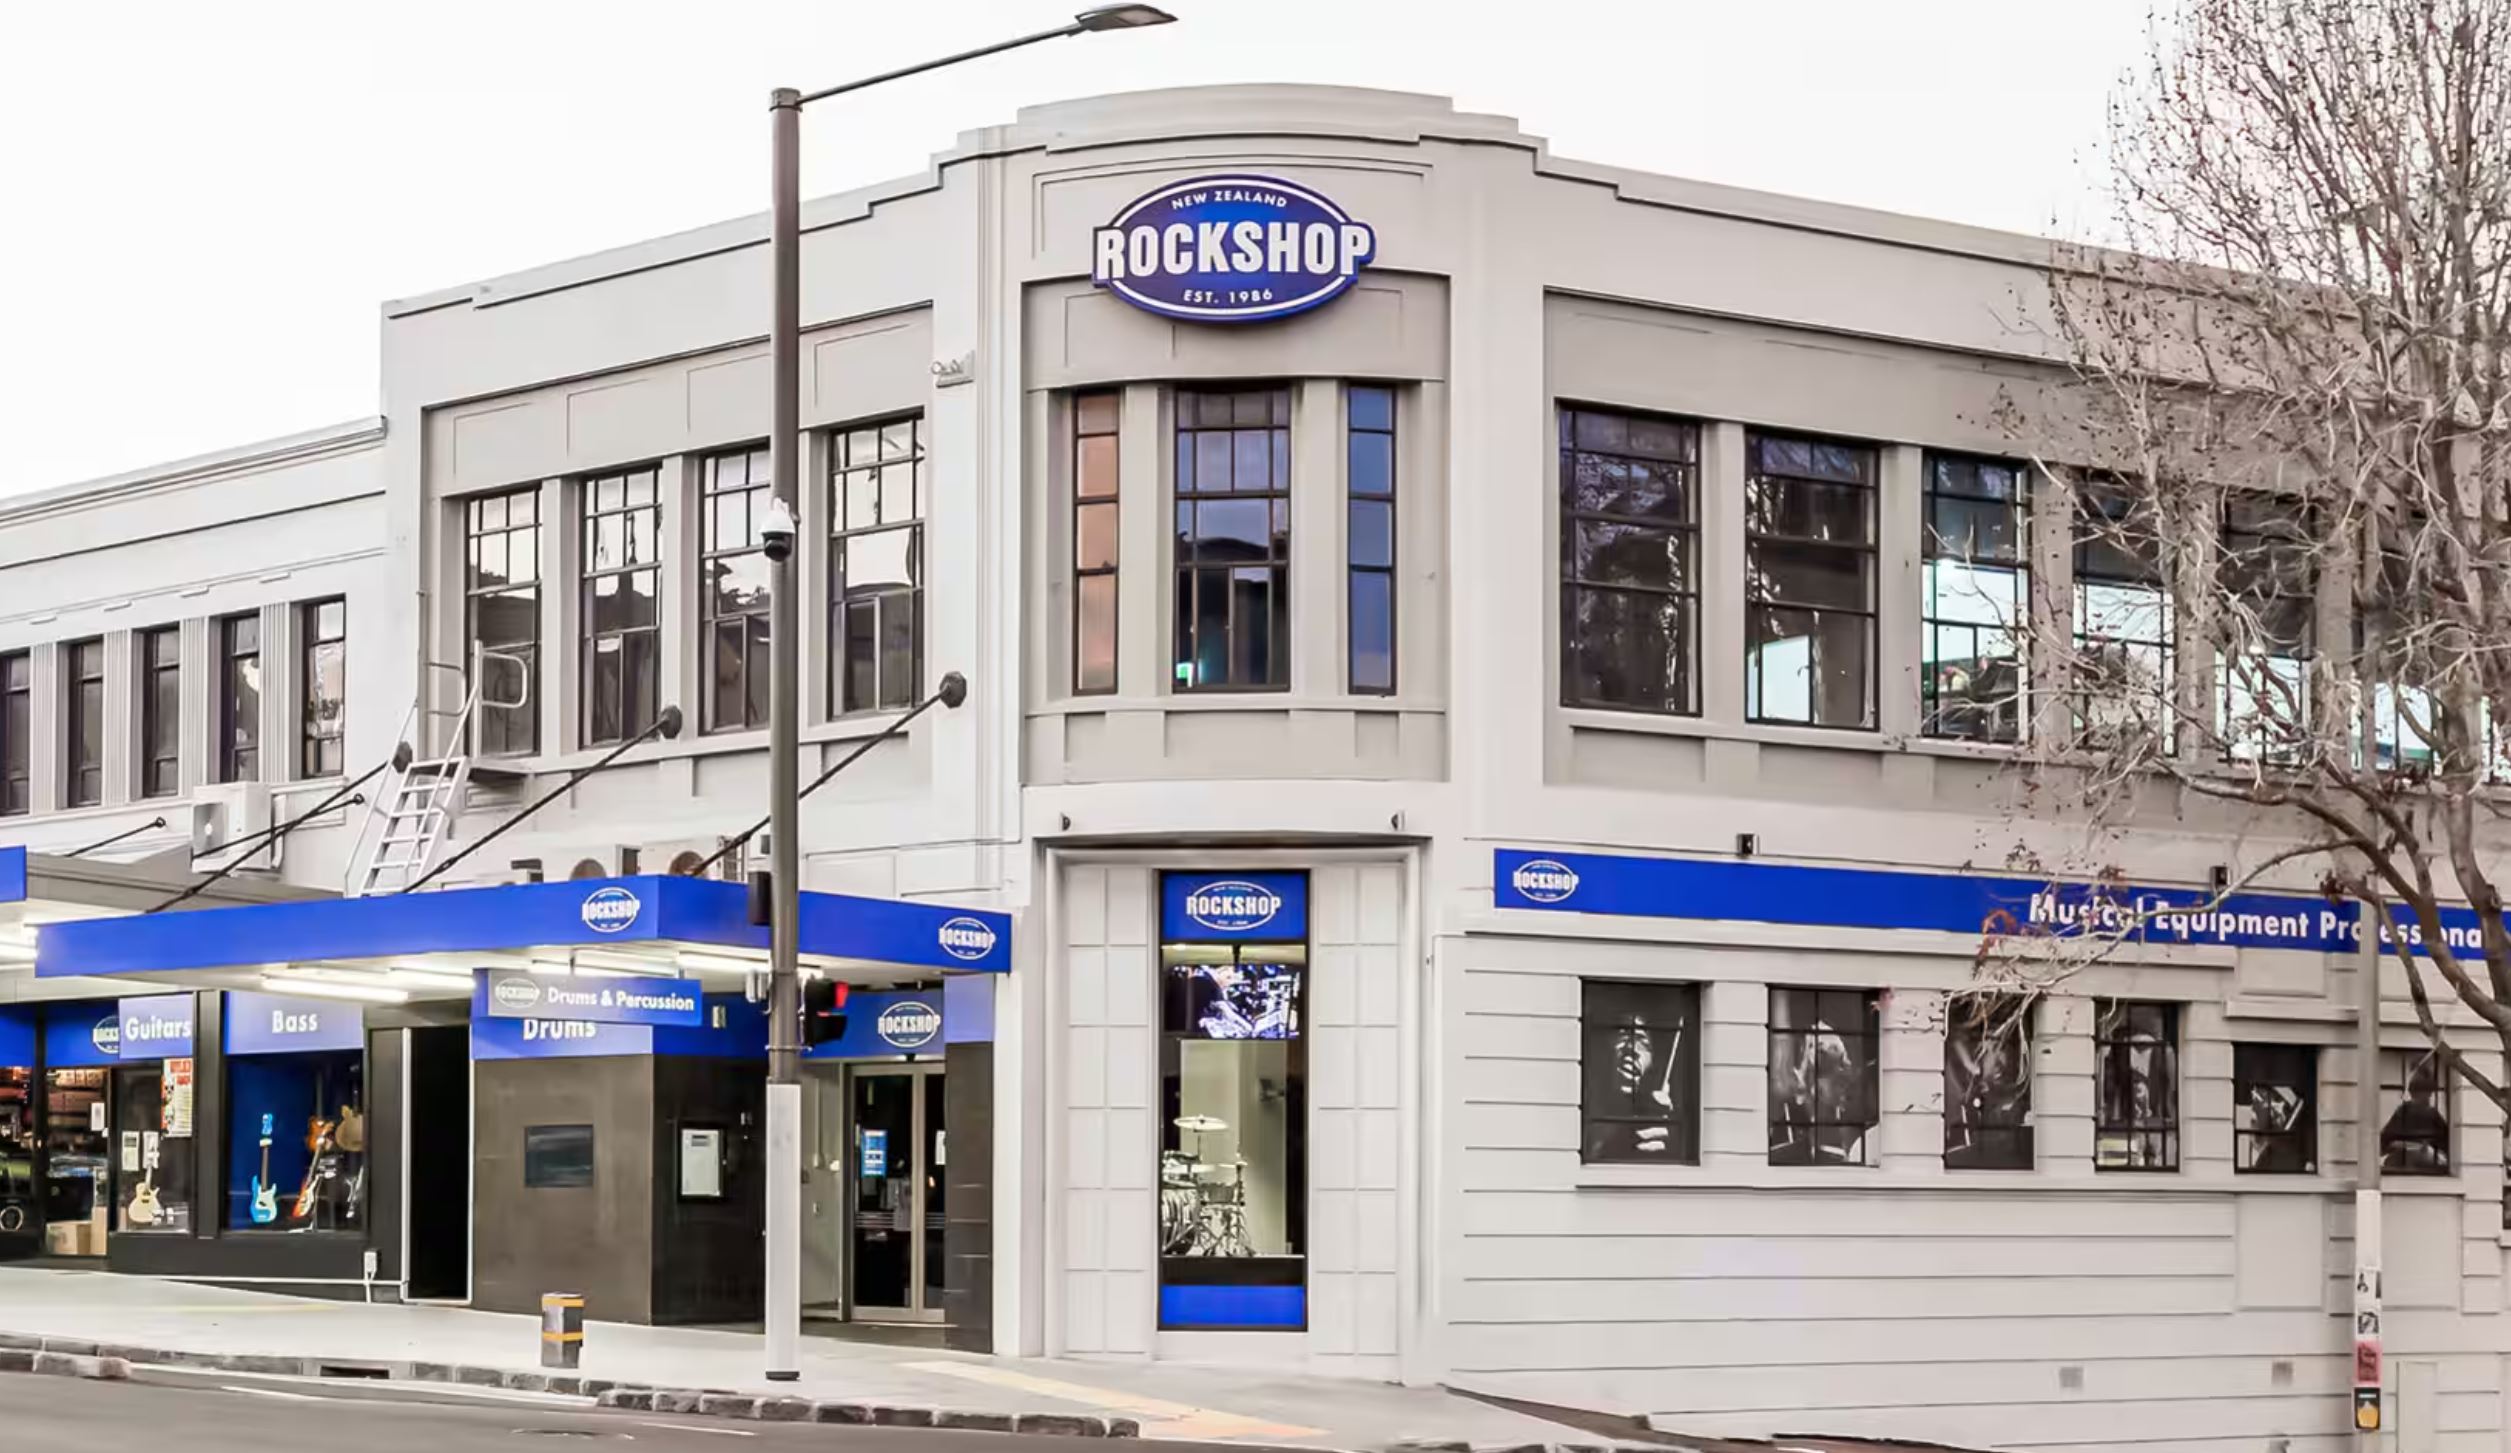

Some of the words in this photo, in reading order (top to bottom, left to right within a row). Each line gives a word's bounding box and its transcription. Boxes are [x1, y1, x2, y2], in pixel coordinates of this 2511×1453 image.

[1171, 192, 1208, 210] NEW
[1214, 190, 1288, 208] ZEALAND
[1096, 220, 1371, 281] ROCKSHOP
[1183, 288, 1220, 304] EST.
[1228, 289, 1273, 304] 1986
[1512, 871, 1579, 890] ROCKSHOP
[582, 899, 640, 920] ROCKSHOP
[1185, 895, 1281, 916] ROCKSHOP
[2155, 900, 2310, 941] Equipment
[938, 928, 997, 948] ROCKSHOP
[548, 986, 597, 1005] Drums
[600, 989, 614, 1007] &
[616, 990, 694, 1011] Percussion
[125, 1015, 192, 1041] Guitars
[271, 1010, 318, 1033] Bass
[523, 1018, 597, 1041] Drums
[878, 1014, 941, 1034] ROCKSHOP
